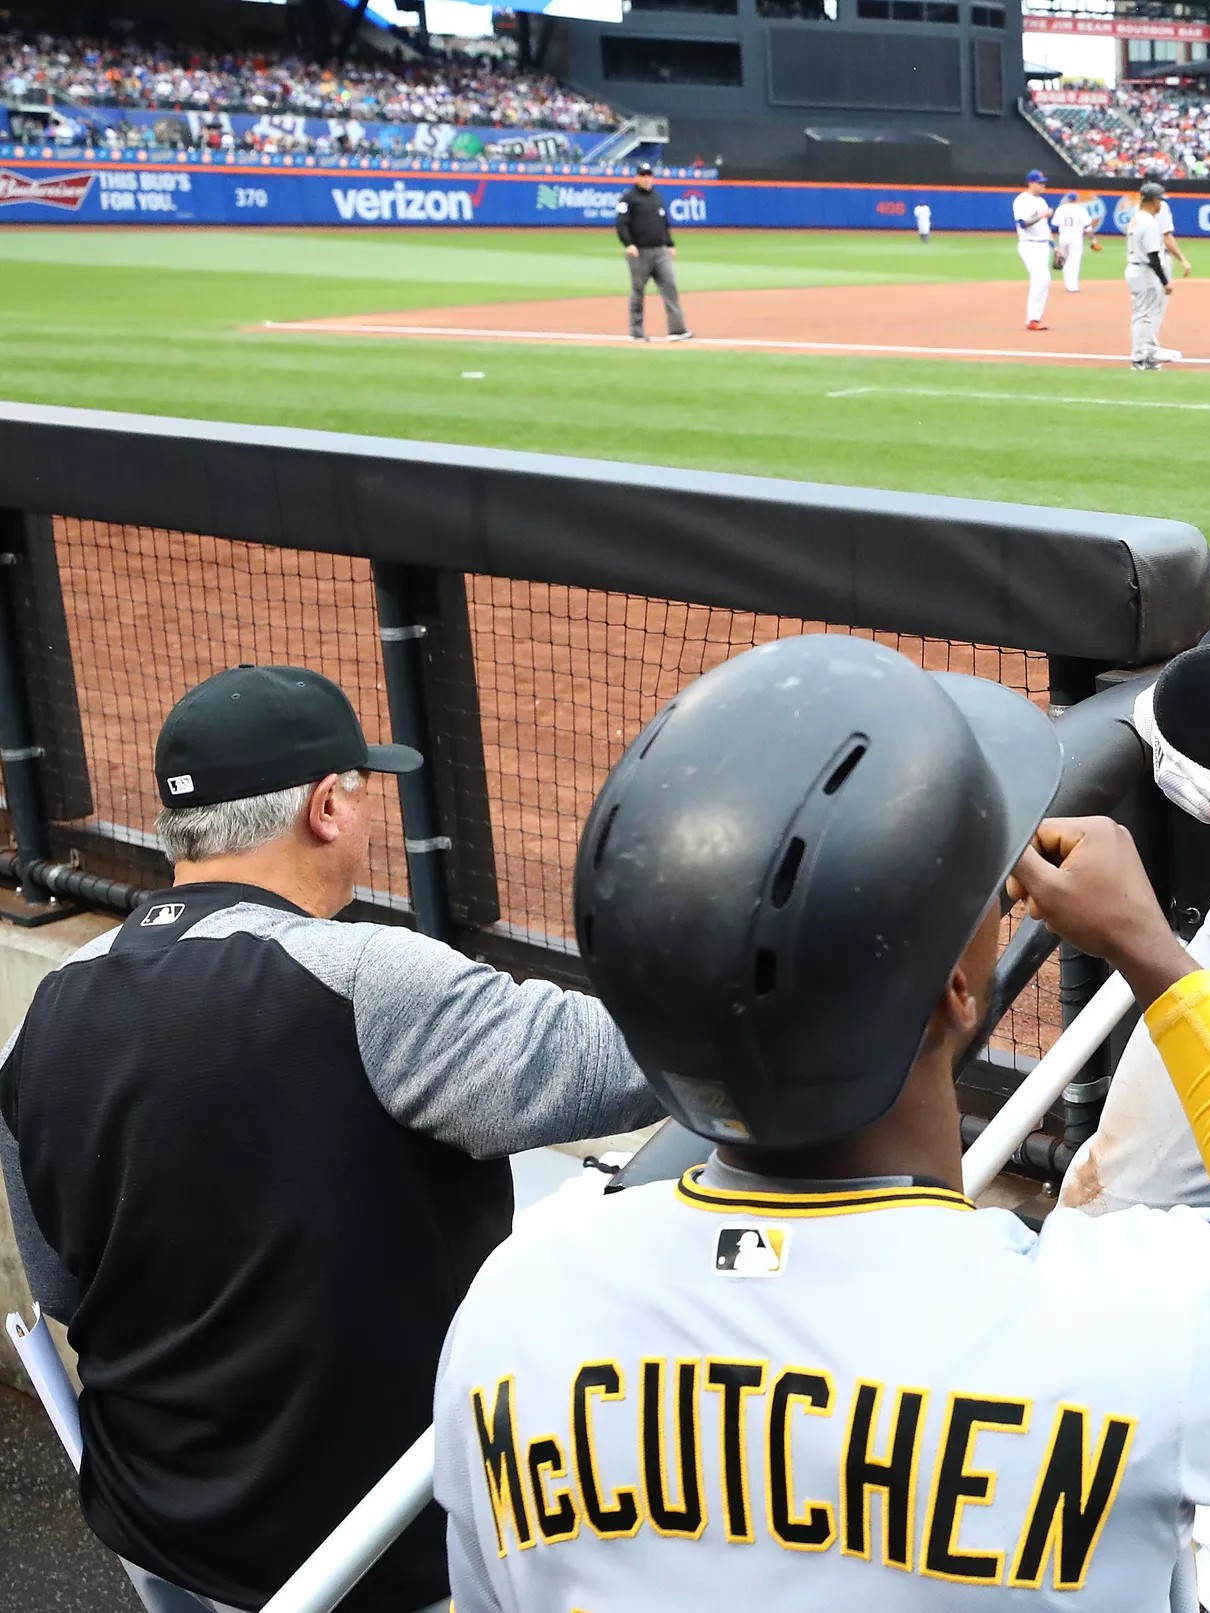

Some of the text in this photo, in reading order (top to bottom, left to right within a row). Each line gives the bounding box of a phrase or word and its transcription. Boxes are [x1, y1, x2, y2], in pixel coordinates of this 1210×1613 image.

[99, 171, 192, 192] THIS BUD'S
[100, 191, 135, 211] FOR
[234, 187, 269, 208] 370
[331, 180, 474, 221] verizon
[669, 193, 707, 221] citi
[468, 1355, 1139, 1592] McCUTCHEN
